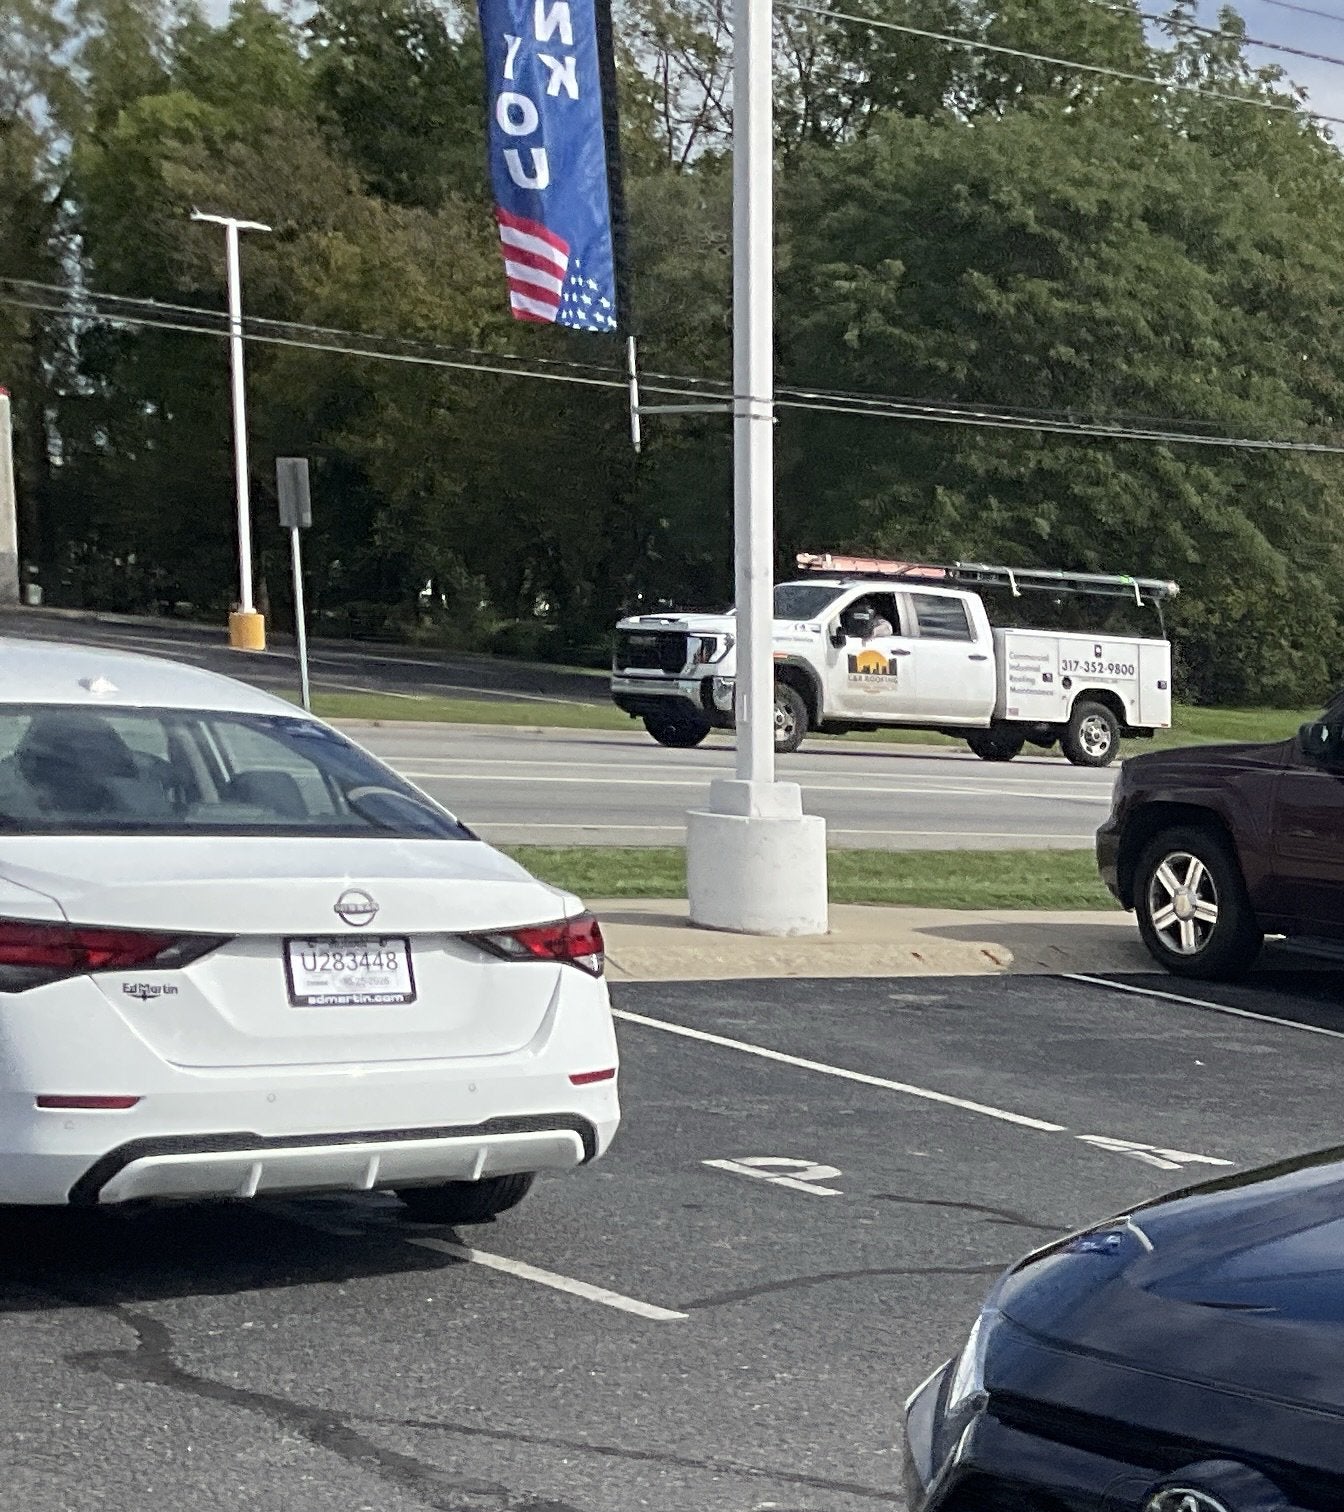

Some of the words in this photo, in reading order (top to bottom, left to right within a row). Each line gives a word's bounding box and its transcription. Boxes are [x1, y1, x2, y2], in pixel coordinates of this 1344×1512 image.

[1062, 659, 1135, 675] 317-352-9800
[301, 951, 398, 972] U283448
[307, 994, 404, 1005] edmartin.com
